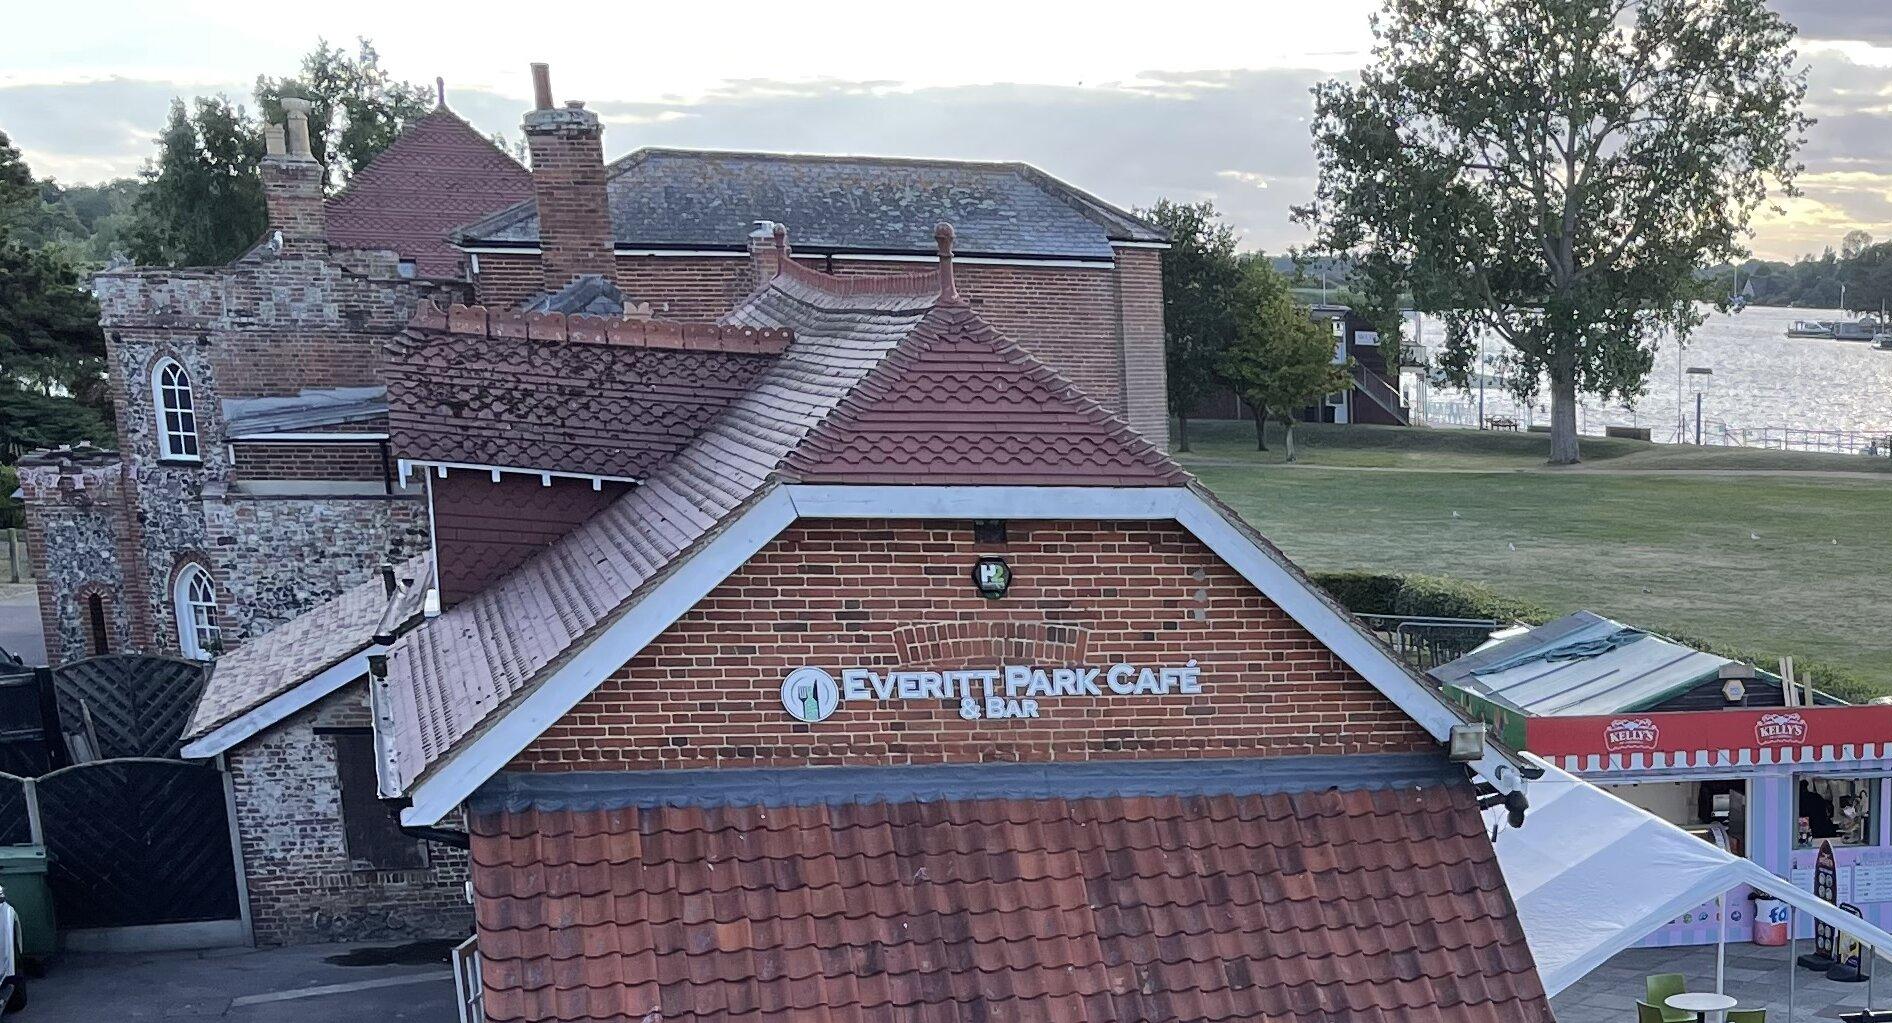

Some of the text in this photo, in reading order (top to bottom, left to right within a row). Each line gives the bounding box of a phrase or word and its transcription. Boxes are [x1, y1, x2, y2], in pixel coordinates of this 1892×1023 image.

[841, 659, 1201, 699] EVERITT PARK CAFÉ
[959, 699, 1040, 720] & BAR
[1609, 730, 1654, 743] KELLY'S
[1759, 724, 1803, 737] KELLY'S
